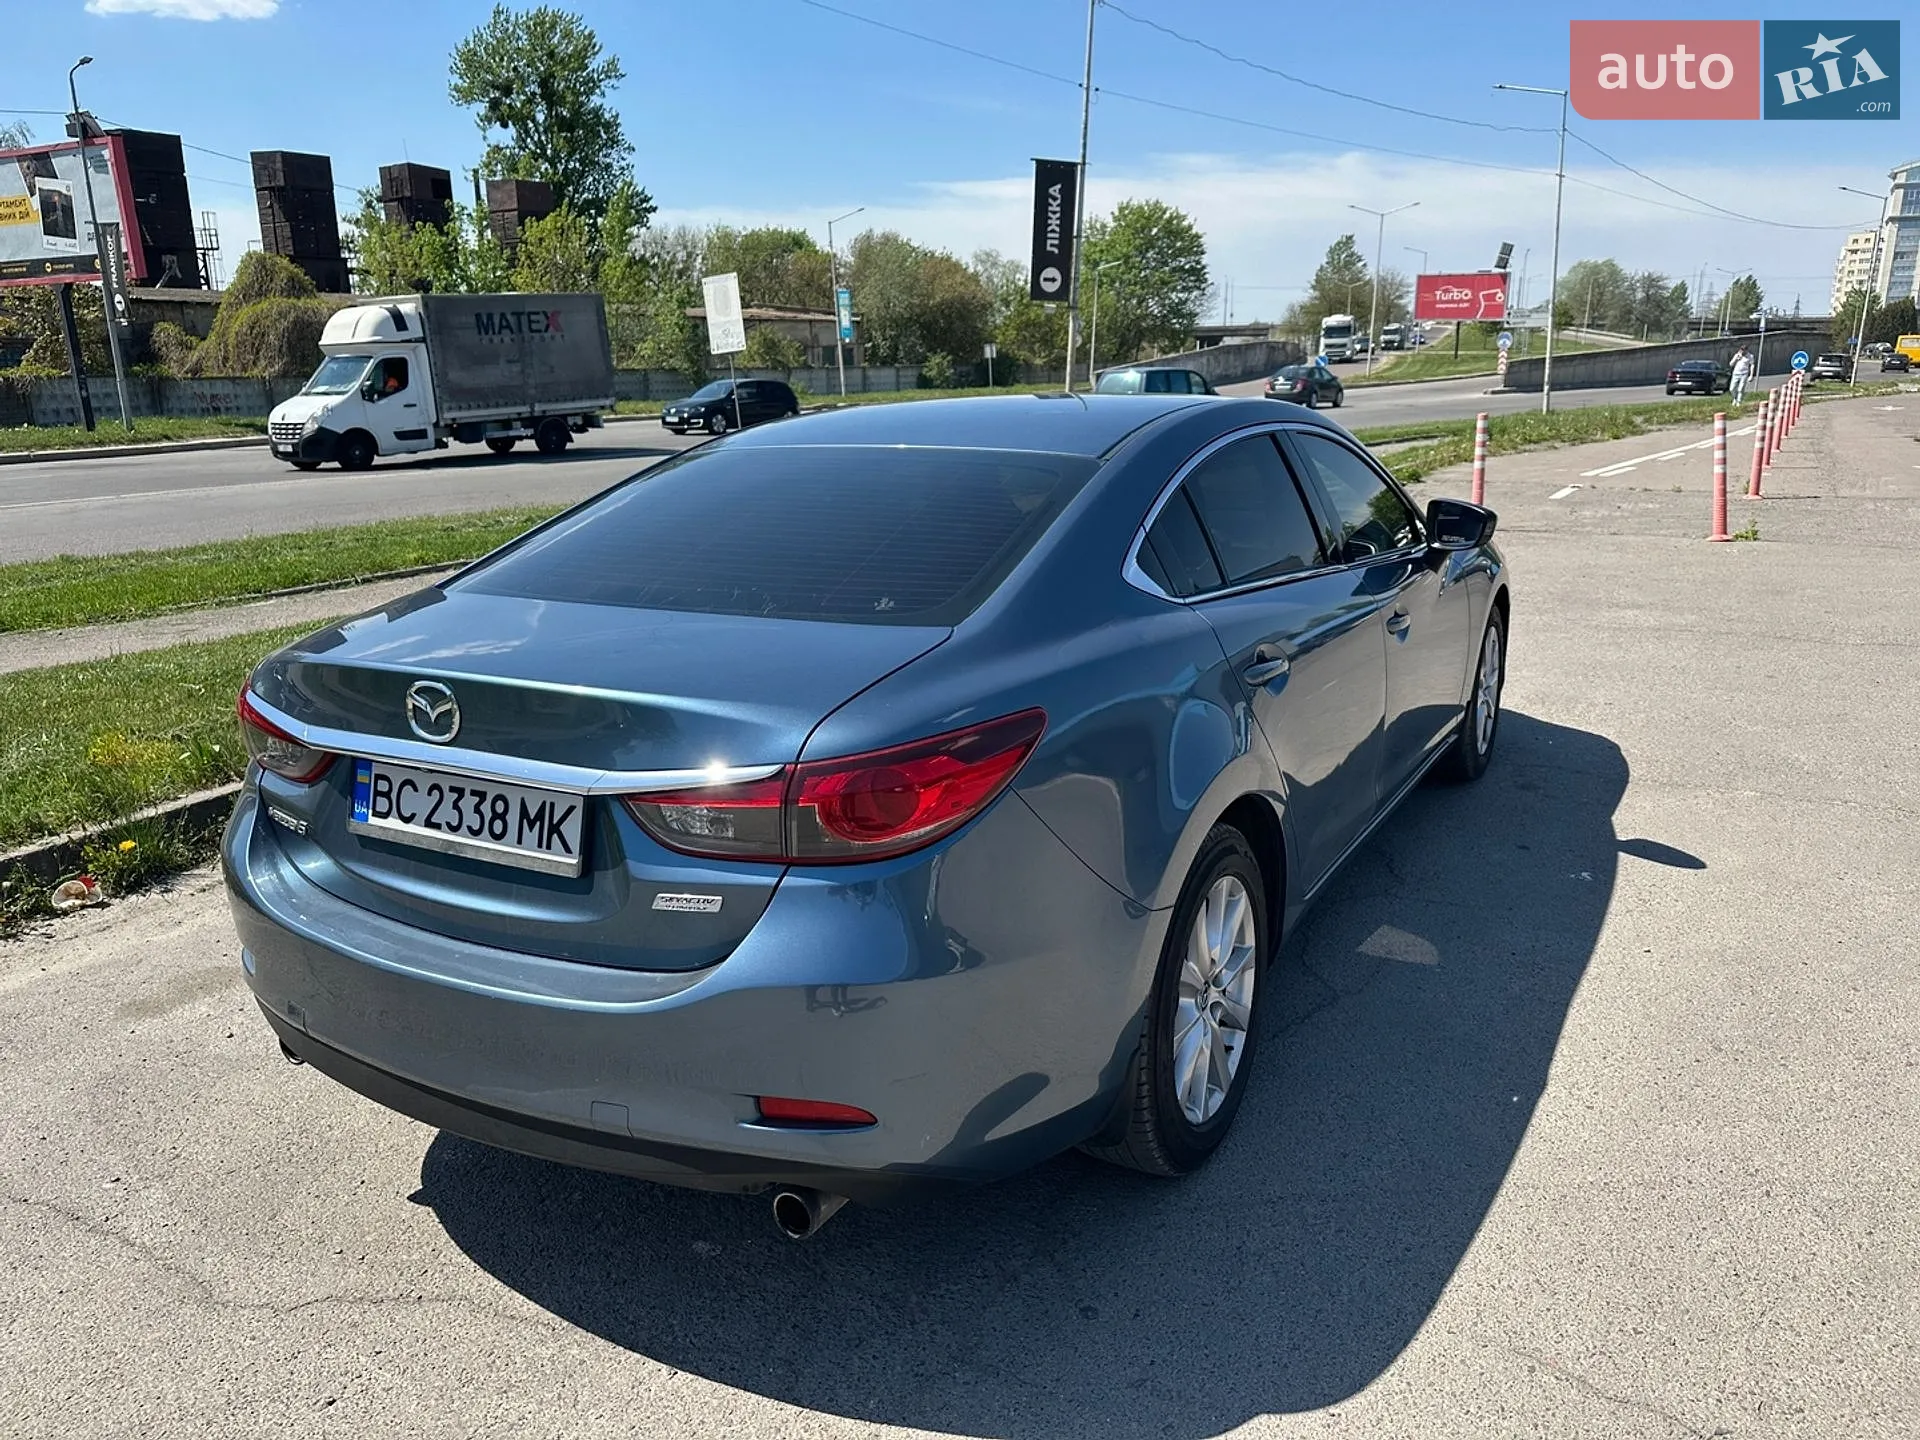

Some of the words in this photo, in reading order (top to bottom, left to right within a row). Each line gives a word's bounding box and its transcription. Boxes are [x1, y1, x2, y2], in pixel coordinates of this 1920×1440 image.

[1046, 183, 1062, 254] ЛІЖКА
[474, 310, 565, 336] MATEX
[354, 802, 368, 813] UA
[424, 783, 510, 841] 2338
